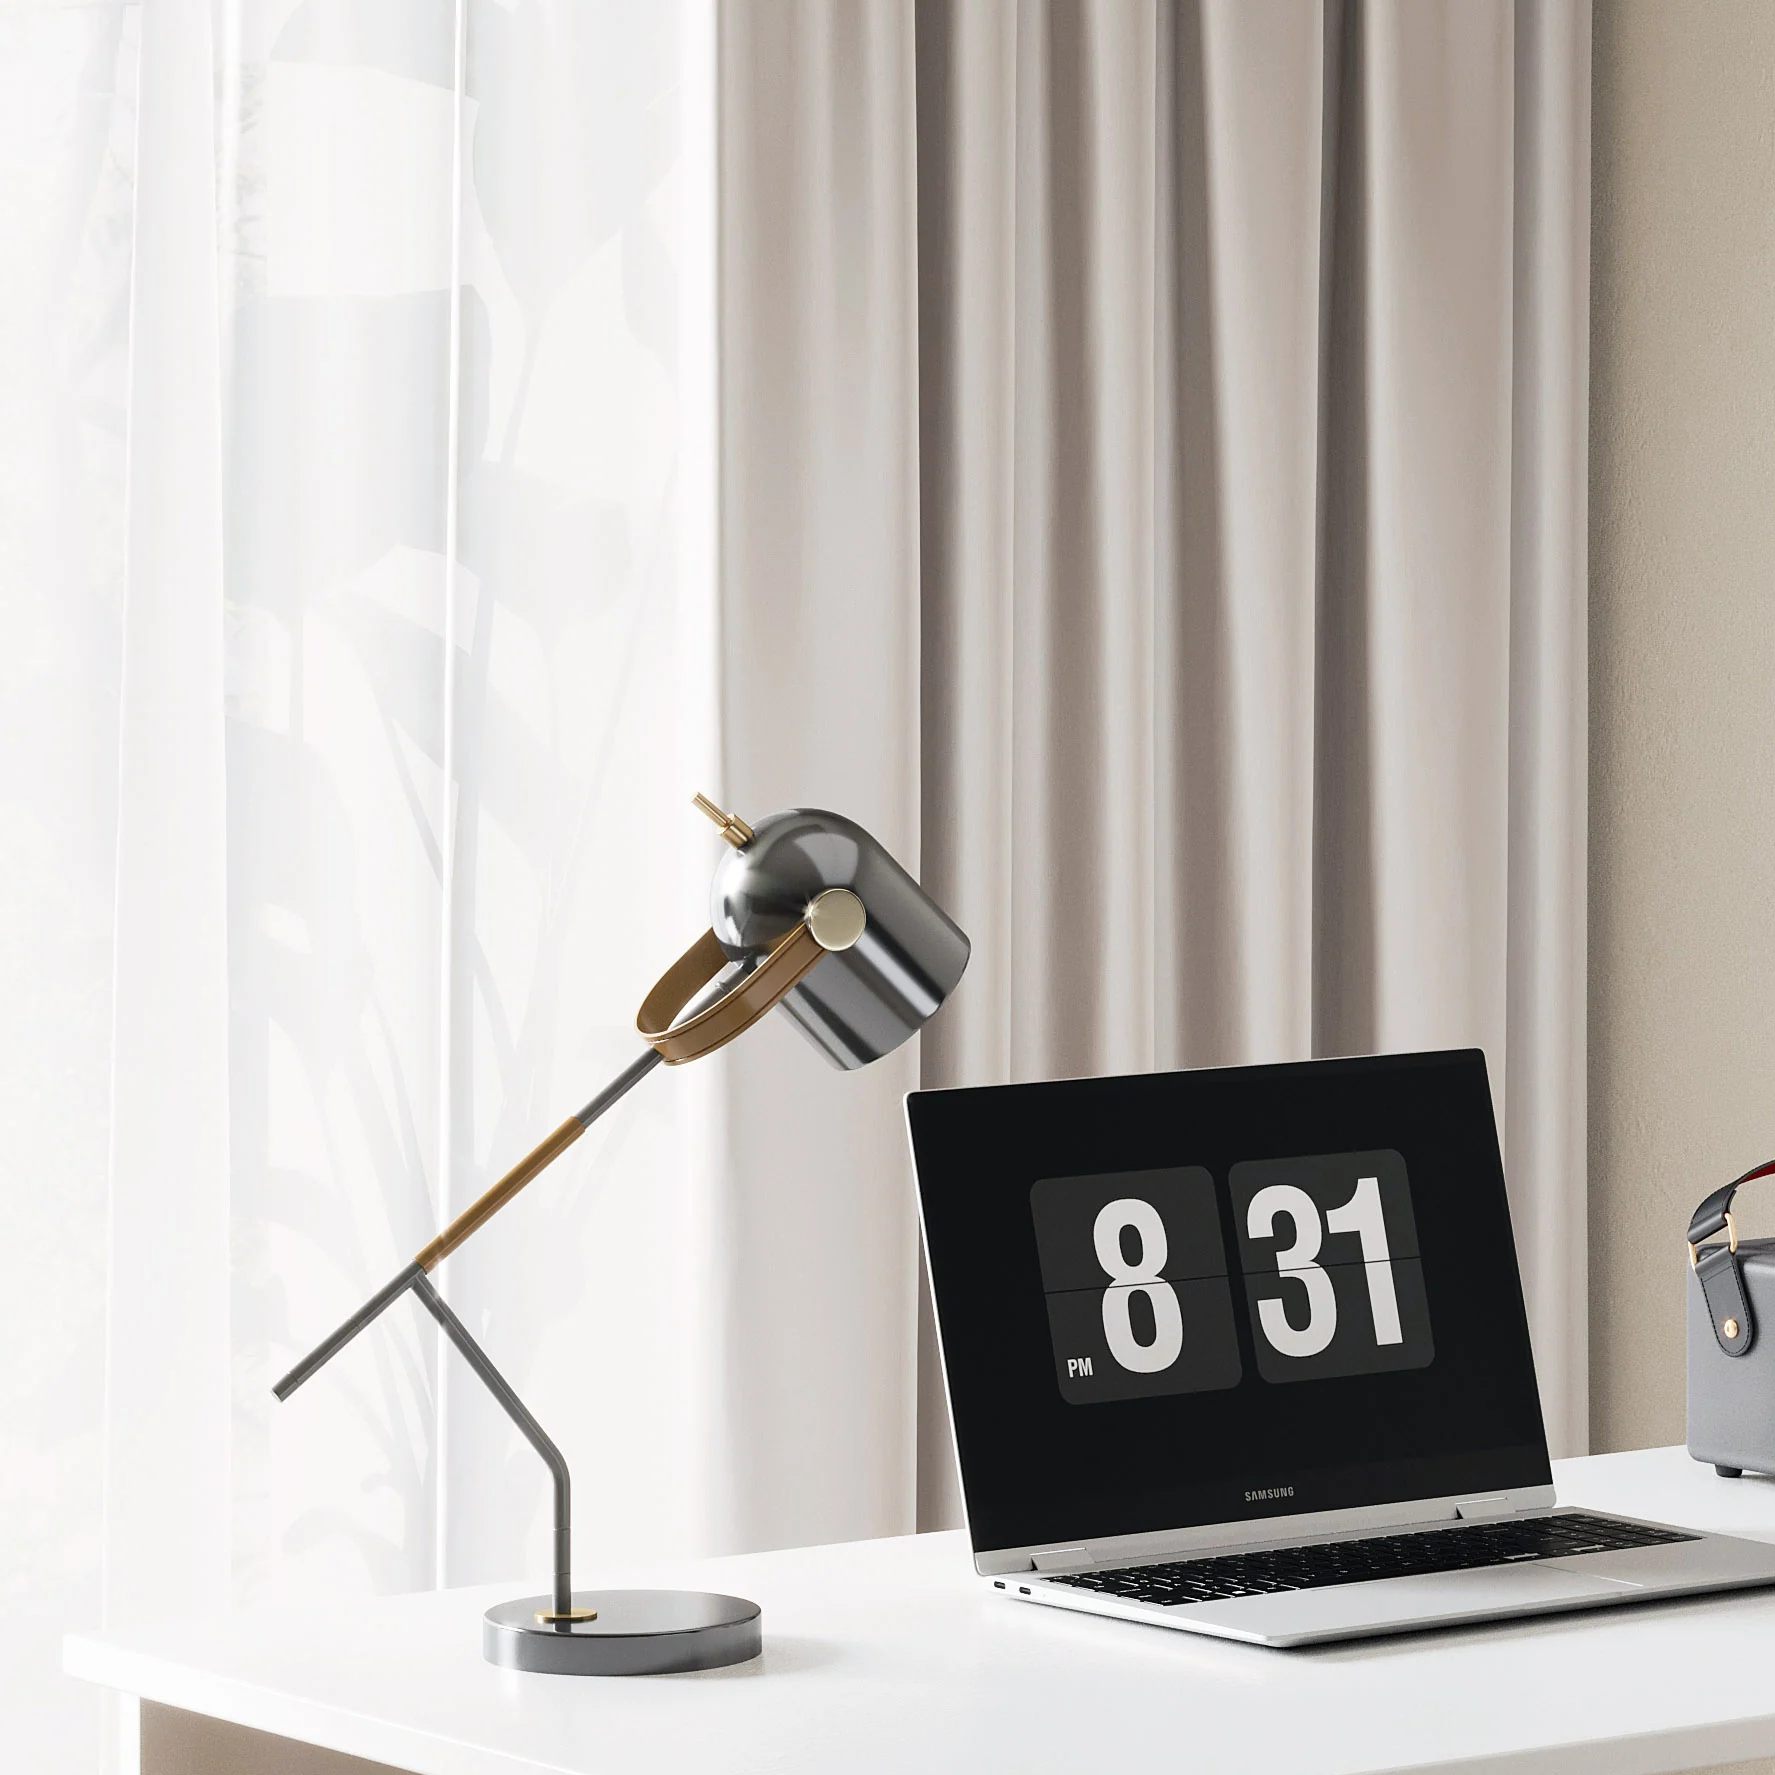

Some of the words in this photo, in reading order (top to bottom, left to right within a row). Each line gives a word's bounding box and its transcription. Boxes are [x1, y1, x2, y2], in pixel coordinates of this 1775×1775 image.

[1092, 1198, 1184, 1375] 8
[1246, 1177, 1403, 1358] 31
[1067, 1358, 1093, 1378] PM
[1244, 1486, 1294, 1502] SAMSUNG
